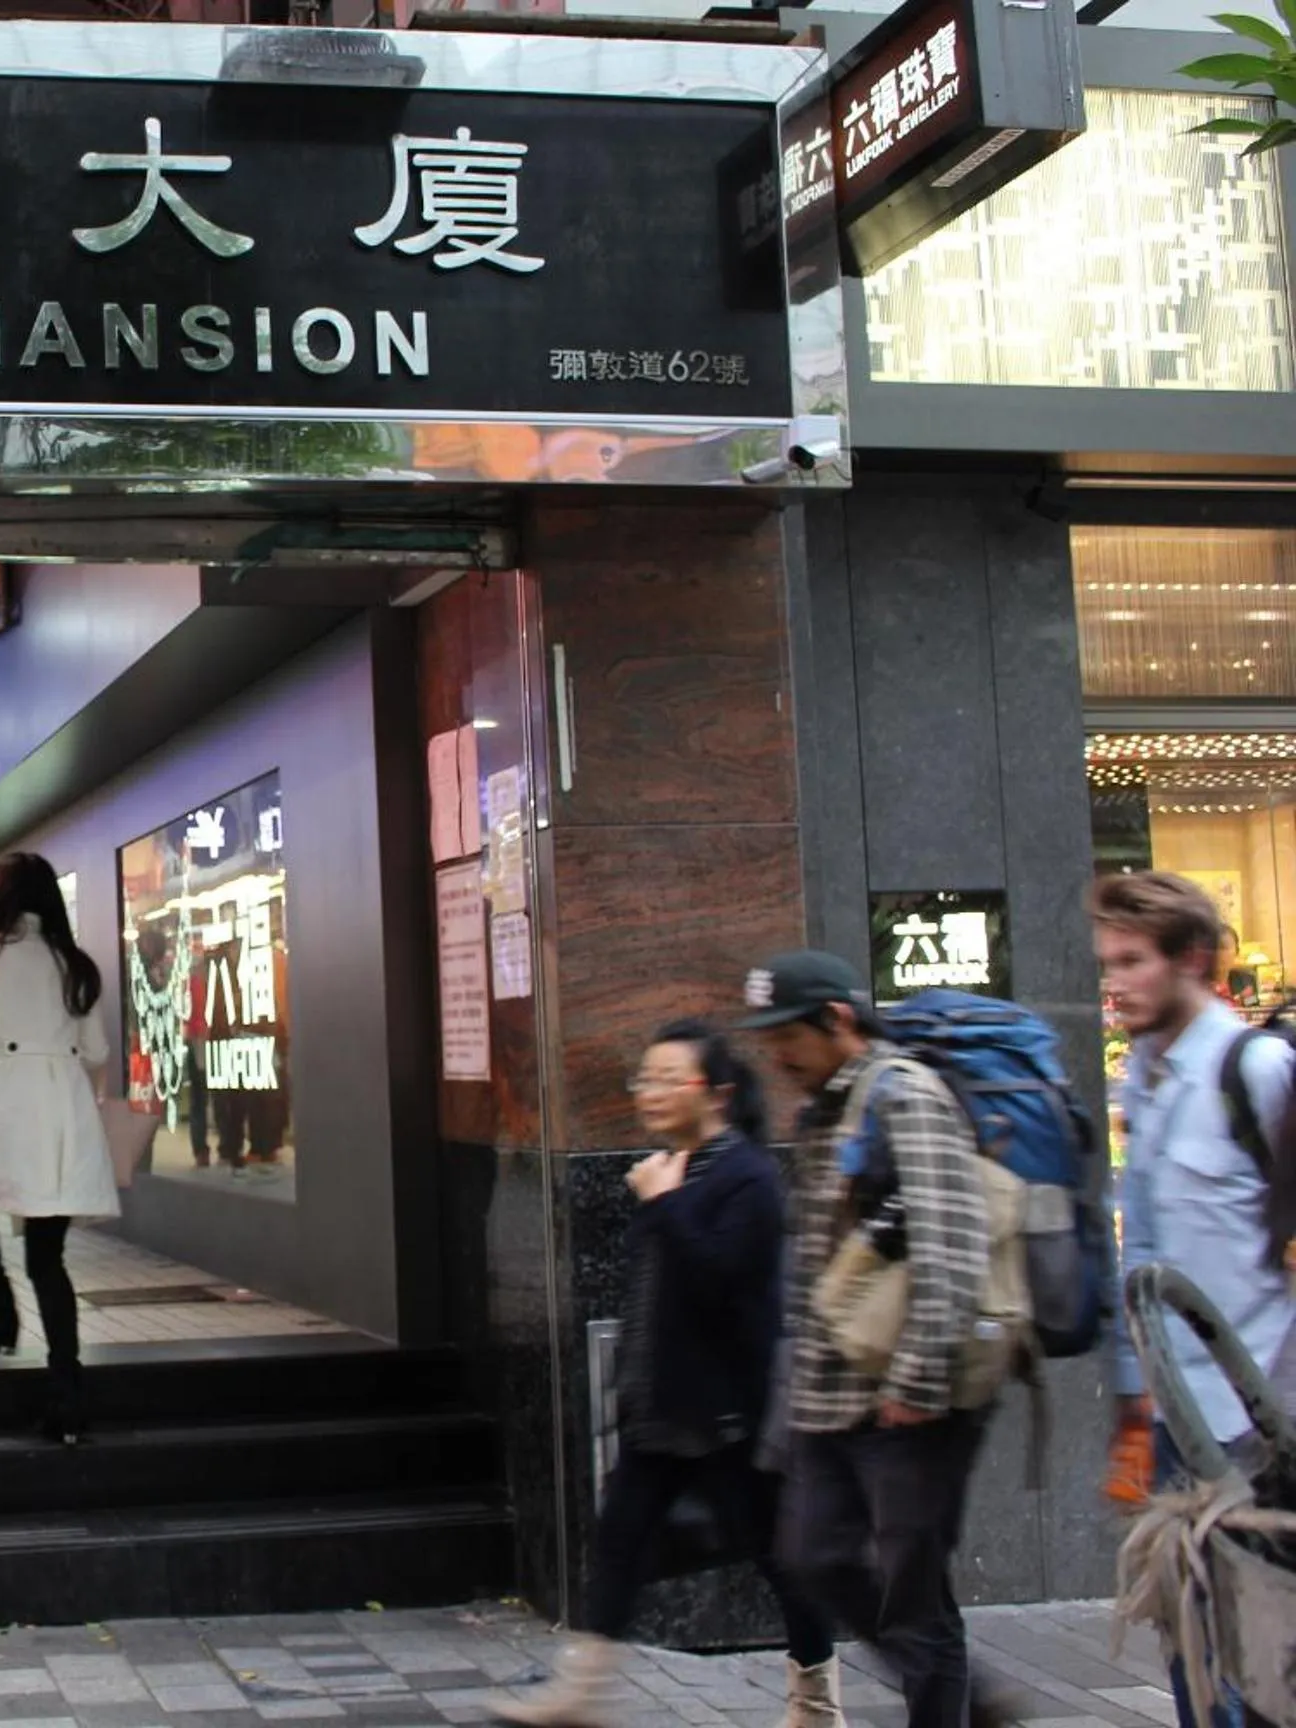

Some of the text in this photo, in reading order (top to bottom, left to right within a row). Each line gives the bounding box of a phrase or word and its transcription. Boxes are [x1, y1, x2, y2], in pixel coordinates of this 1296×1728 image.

[842, 19, 957, 158] 六福珠寶
[846, 74, 961, 180] LUKFOOK JEWELLERY
[549, 349, 750, 386] 彌敦道62號
